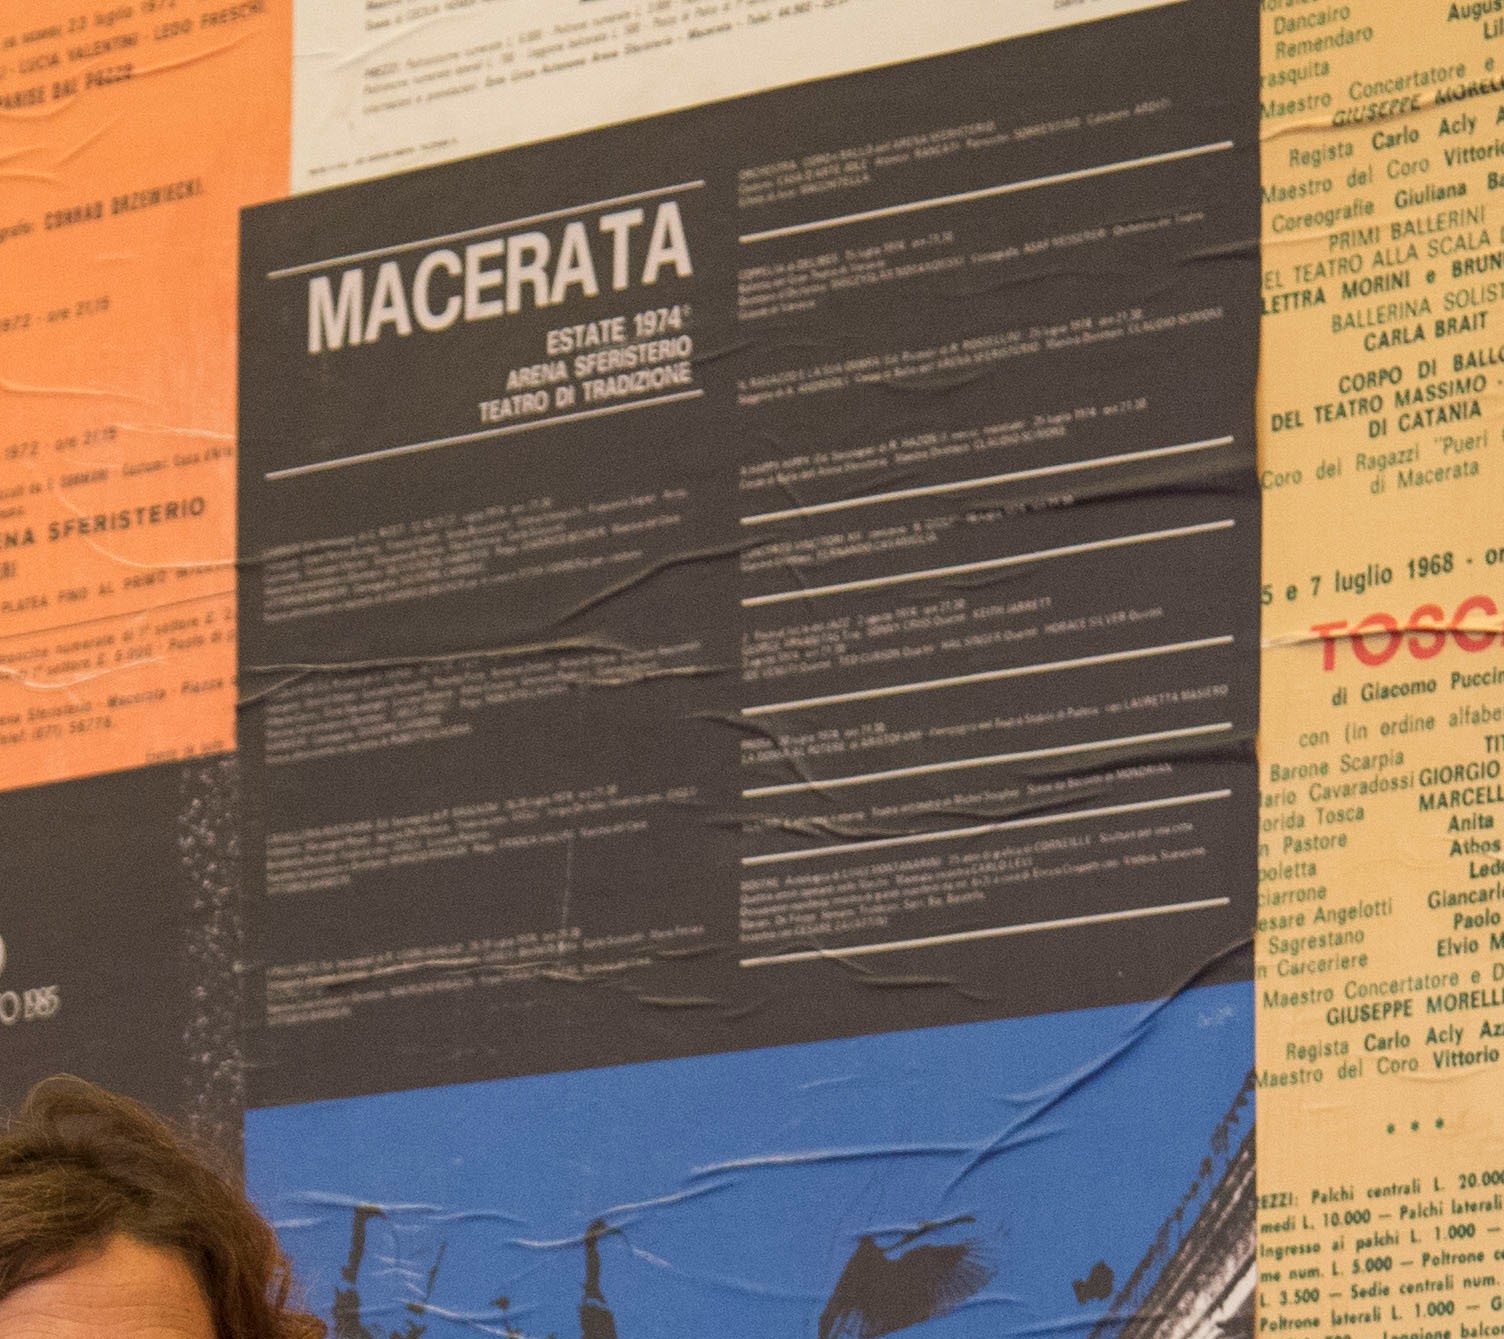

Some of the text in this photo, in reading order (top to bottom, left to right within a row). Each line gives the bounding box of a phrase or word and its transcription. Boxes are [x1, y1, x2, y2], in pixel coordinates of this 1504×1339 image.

[1372, 128, 1420, 151] Carlo
[1394, 183, 1467, 210] Giuliana
[1329, 206, 1485, 251] PRIMI BALLERINI
[1294, 255, 1362, 282] TEATRO
[1427, 229, 1490, 259] SCALA
[307, 201, 692, 355] MACERATA
[1342, 270, 1411, 300] MORINI
[546, 315, 625, 355] ESTATE
[1364, 312, 1488, 352] CARLA BRAIT
[506, 335, 692, 391] ARENA SFERISTERIO
[1338, 367, 1402, 395] CORPO
[479, 361, 692, 423] TEATRO TRADIZIONE
[1272, 410, 1304, 433] DEL
[1314, 394, 1383, 424] TEATRO
[1394, 374, 1486, 409] MASSIMO
[1398, 400, 1482, 433] CATANIA
[48, 496, 206, 542] SFERISTERIO
[1336, 565, 1393, 595] luglio
[1408, 552, 1454, 579] 1968
[1361, 675, 1436, 702] Giacomo
[1419, 761, 1501, 788] GIORGIO
[1326, 999, 1413, 1026] GIUSEPPE
